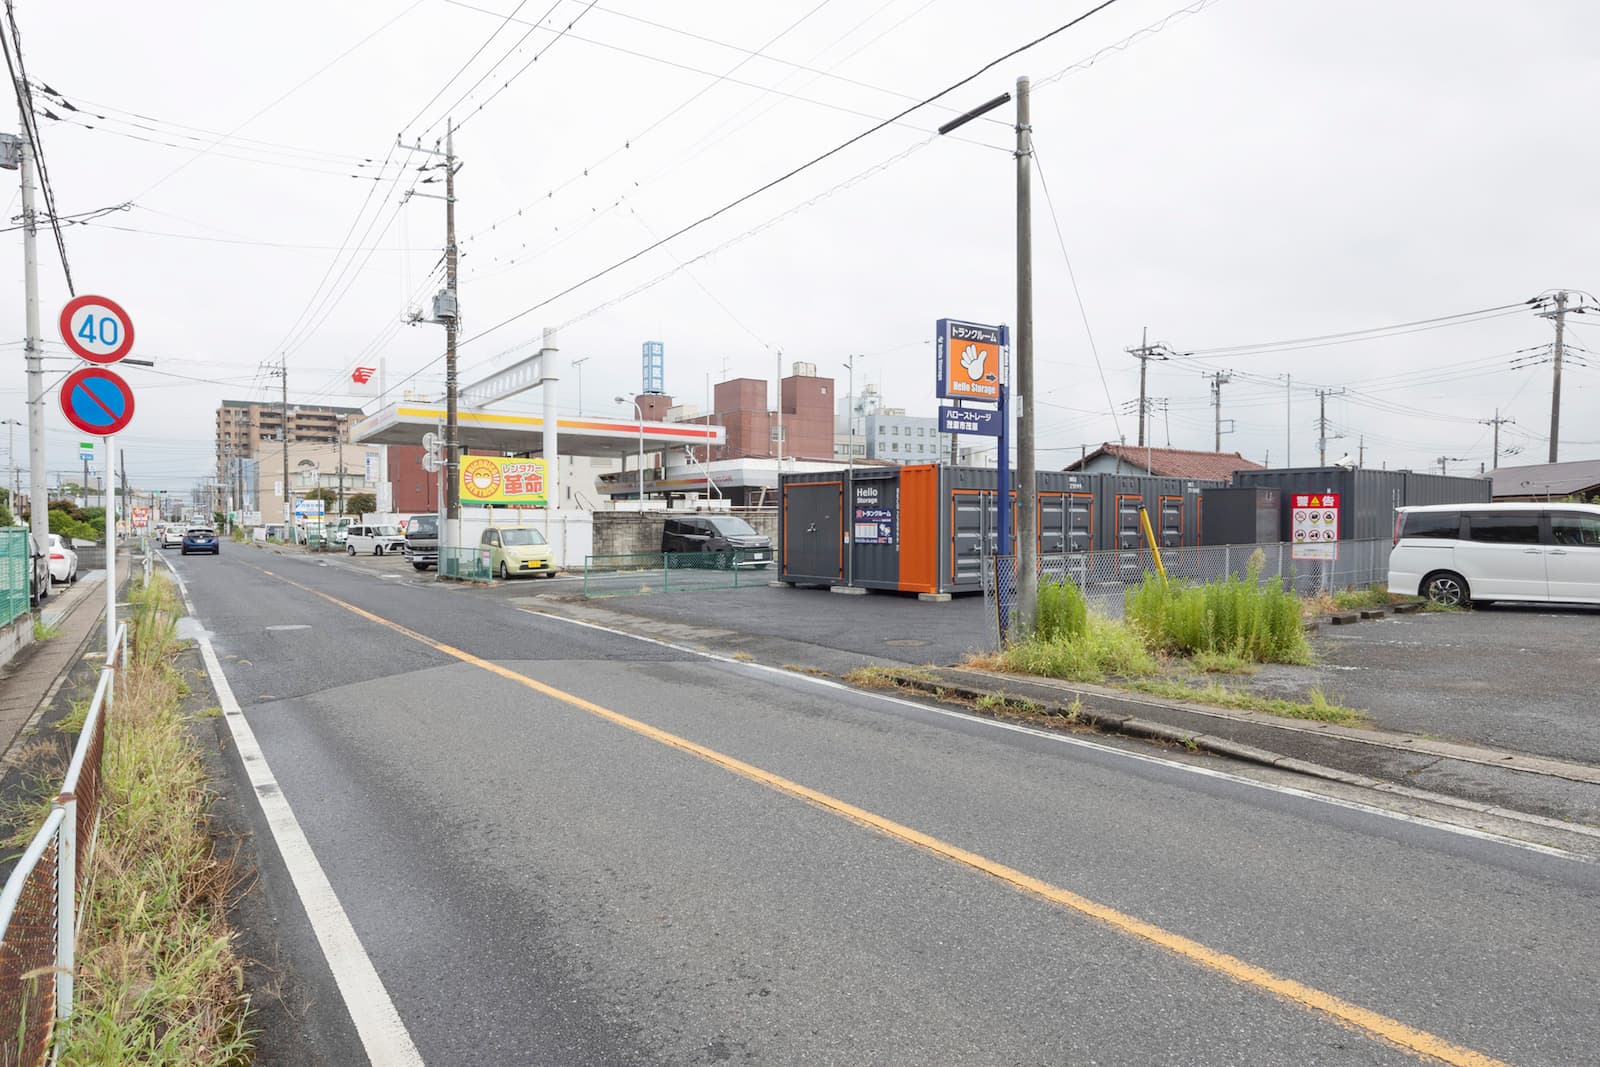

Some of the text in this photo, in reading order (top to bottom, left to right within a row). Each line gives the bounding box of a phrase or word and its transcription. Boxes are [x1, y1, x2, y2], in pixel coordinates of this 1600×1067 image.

[78, 314, 118, 346] 40
[952, 327, 997, 342] トランクルーム
[953, 381, 996, 395] Hello Storage
[946, 409, 992, 422] ハローストレージ
[502, 463, 543, 474] レンタカー
[503, 473, 543, 494] 革命
[857, 488, 878, 497] Hello
[857, 497, 878, 505] Storage
